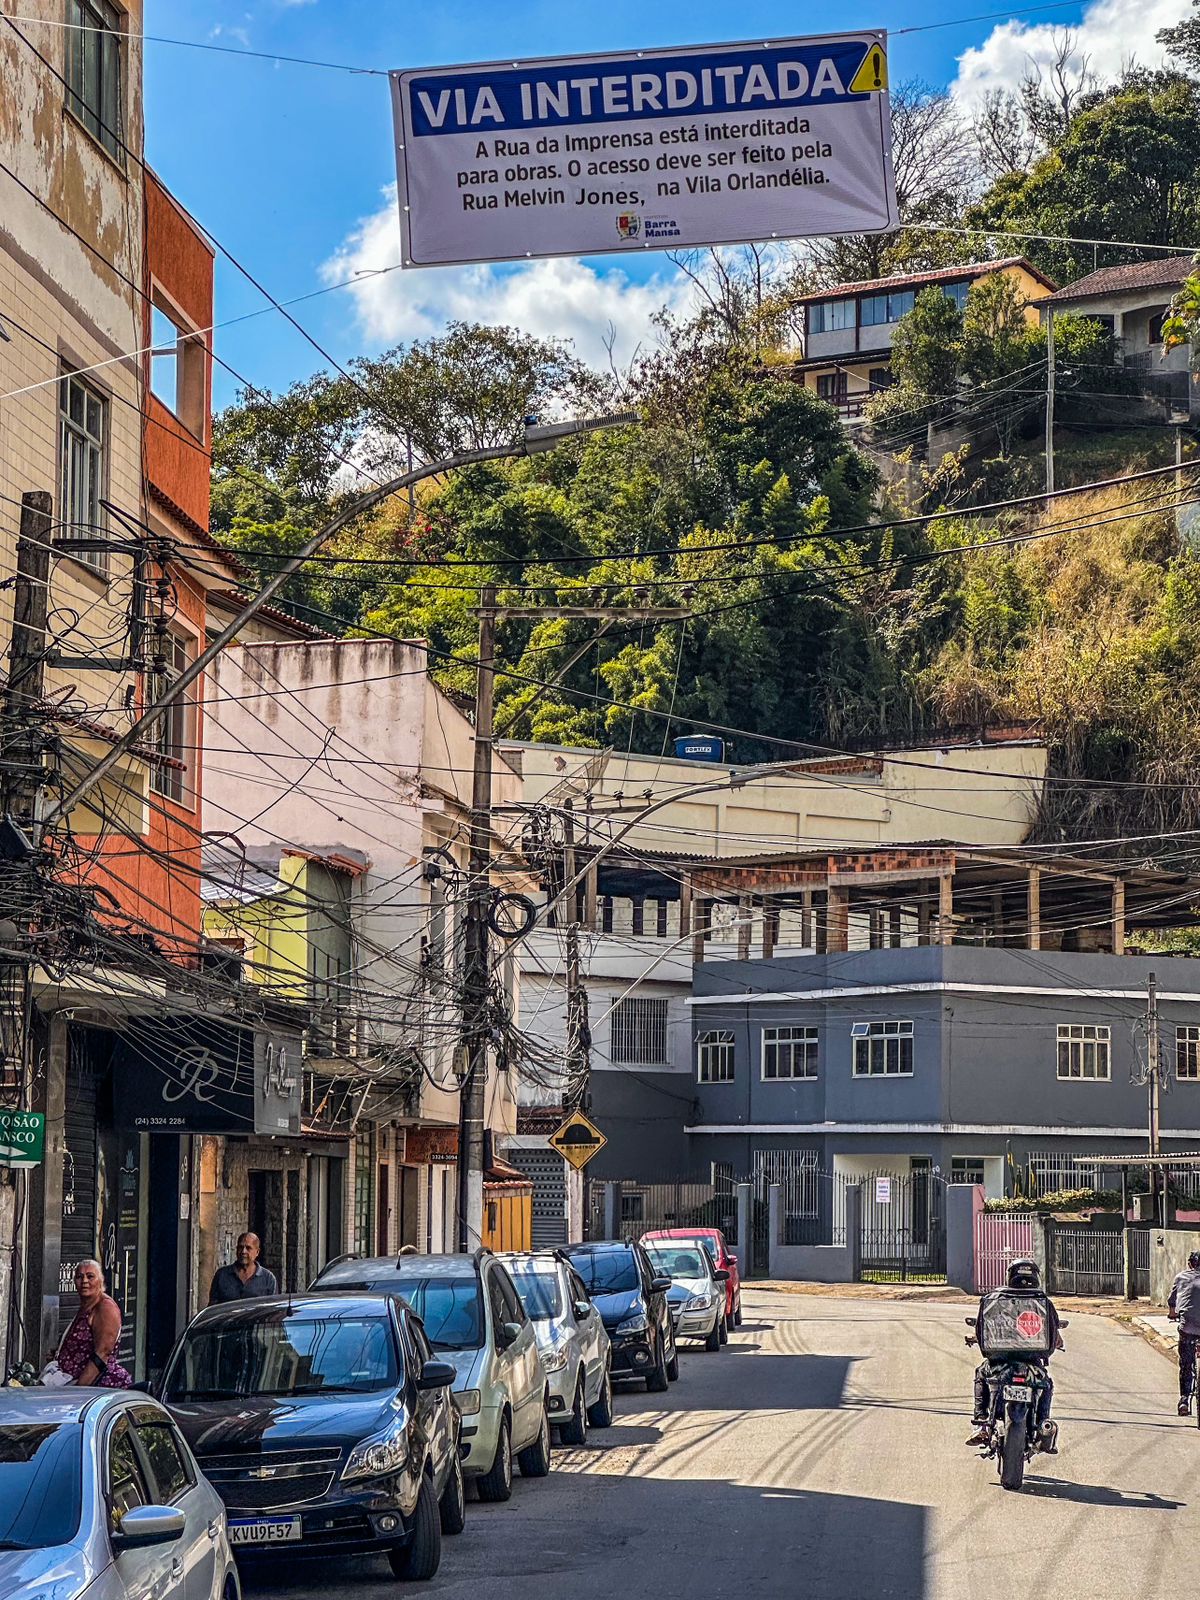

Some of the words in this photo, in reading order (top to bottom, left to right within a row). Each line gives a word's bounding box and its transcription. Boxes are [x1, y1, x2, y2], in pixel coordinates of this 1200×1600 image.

[418, 86, 505, 127] VIA
[520, 58, 846, 120] INTERDITADA
[475, 141, 489, 158] A
[494, 139, 530, 157] Rua
[536, 136, 559, 153] da
[565, 131, 653, 152] Imprensa
[659, 124, 699, 144] está
[704, 116, 810, 141] interditada
[457, 168, 499, 188] para
[504, 164, 562, 182] obras.
[568, 159, 581, 177] O
[587, 157, 650, 175] acesso
[656, 152, 701, 170] deve
[707, 151, 736, 167] ser
[742, 145, 786, 164] feito
[792, 140, 832, 162] pela
[463, 193, 498, 211] Rua
[504, 188, 565, 207] Melvin
[575, 188, 645, 207] Jones,
[657, 181, 680, 196] na
[685, 175, 721, 194] Vila
[727, 167, 830, 191] Orlandélia.
[644, 220, 677, 229] Barra
[645, 229, 681, 238] Mansa
[14, 1114, 40, 1128] SÃO
[134, 1117, 150, 1126] (24)
[150, 1117, 167, 1125] 3324
[233, 1524, 292, 1541] KVU9F57
